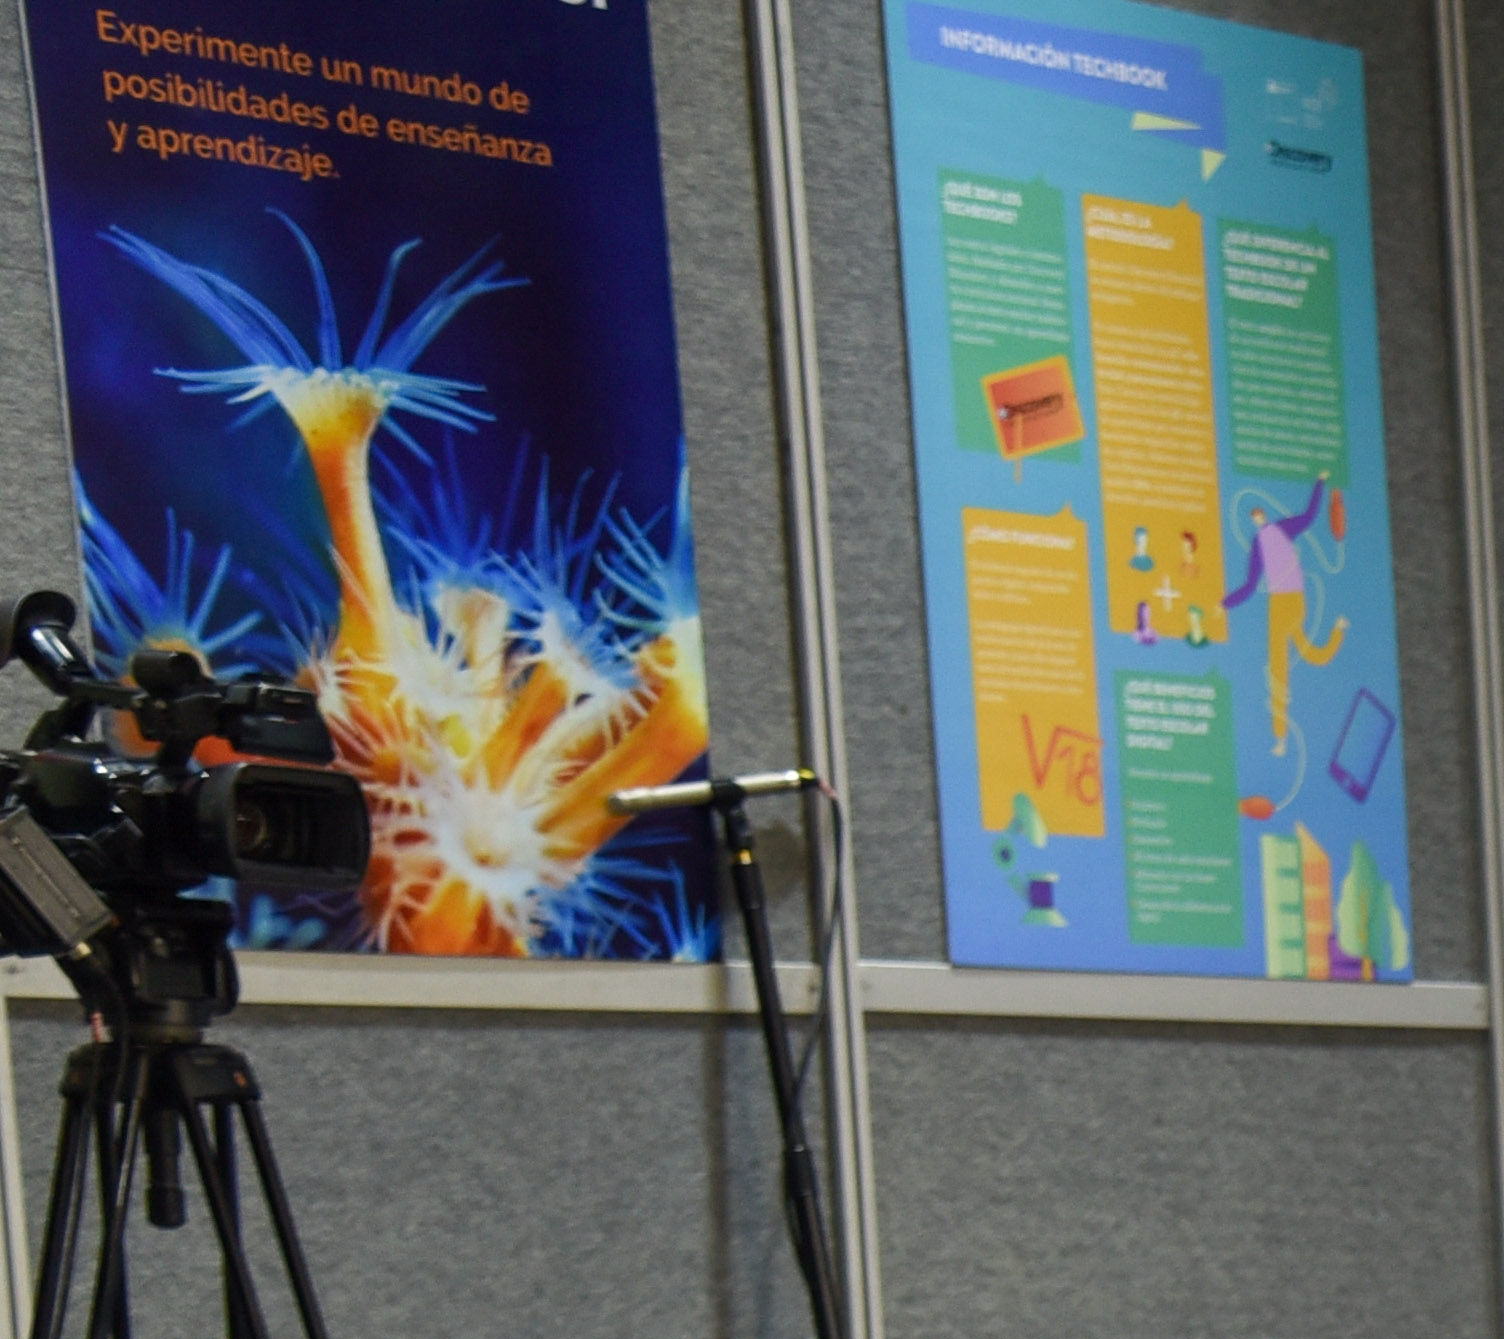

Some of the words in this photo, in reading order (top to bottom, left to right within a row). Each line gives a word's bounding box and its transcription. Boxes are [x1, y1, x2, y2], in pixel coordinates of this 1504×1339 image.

[96, 9, 312, 77] Experimente
[321, 56, 363, 86] un
[371, 64, 482, 108] mundo
[489, 82, 530, 114] de
[940, 26, 1071, 71] INFORMACIÓN
[1073, 52, 1168, 91] TECHBOOK
[102, 68, 329, 132] posibilidades
[337, 105, 379, 139] de
[387, 118, 553, 167] enseñanza
[107, 120, 129, 153] y
[136, 124, 340, 181] aprendizaje.
